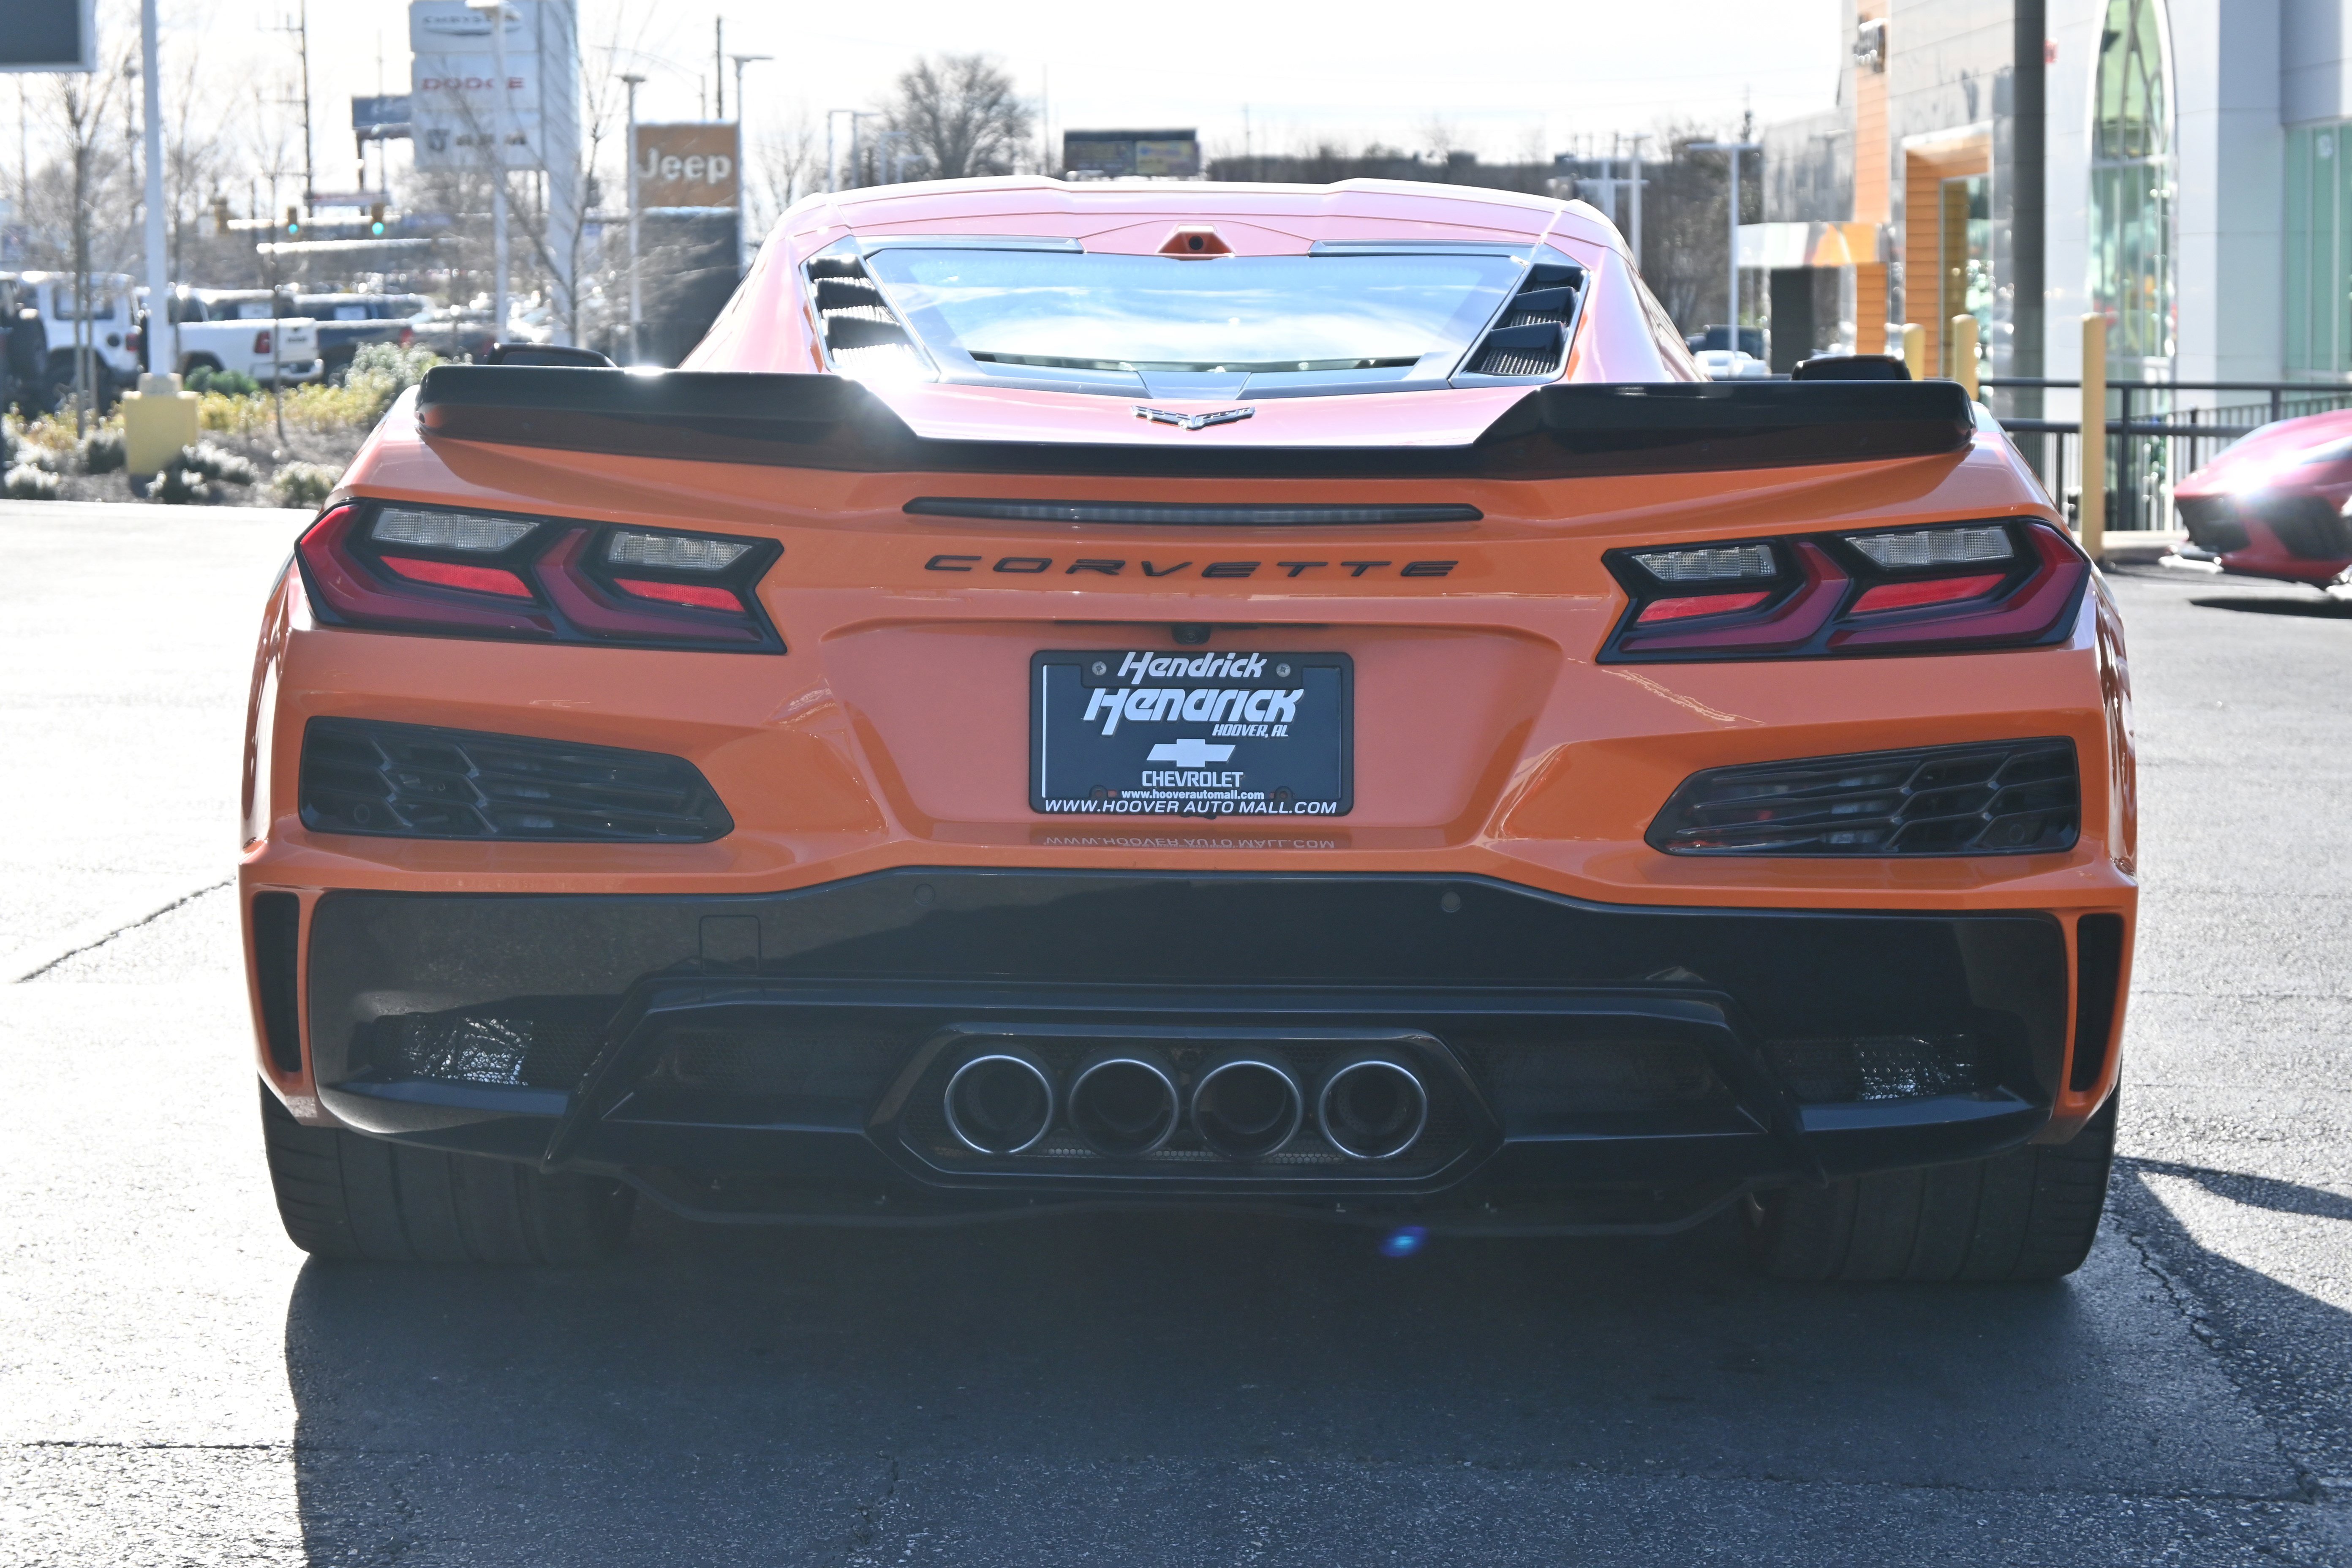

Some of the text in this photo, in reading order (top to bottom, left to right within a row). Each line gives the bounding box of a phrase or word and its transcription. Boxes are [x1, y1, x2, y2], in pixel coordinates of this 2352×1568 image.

[637, 148, 731, 184] Jeep
[924, 555, 1458, 577] CORVETTE
[1117, 652, 1267, 684] Hendrick
[1212, 724, 1288, 737] HOOVER, AL
[1142, 771, 1244, 787] CHEVROLET
[1122, 789, 1264, 800] www.hooverautomall.com
[1045, 800, 1337, 814] WWW.HOOVER AUTO MALL.COM
